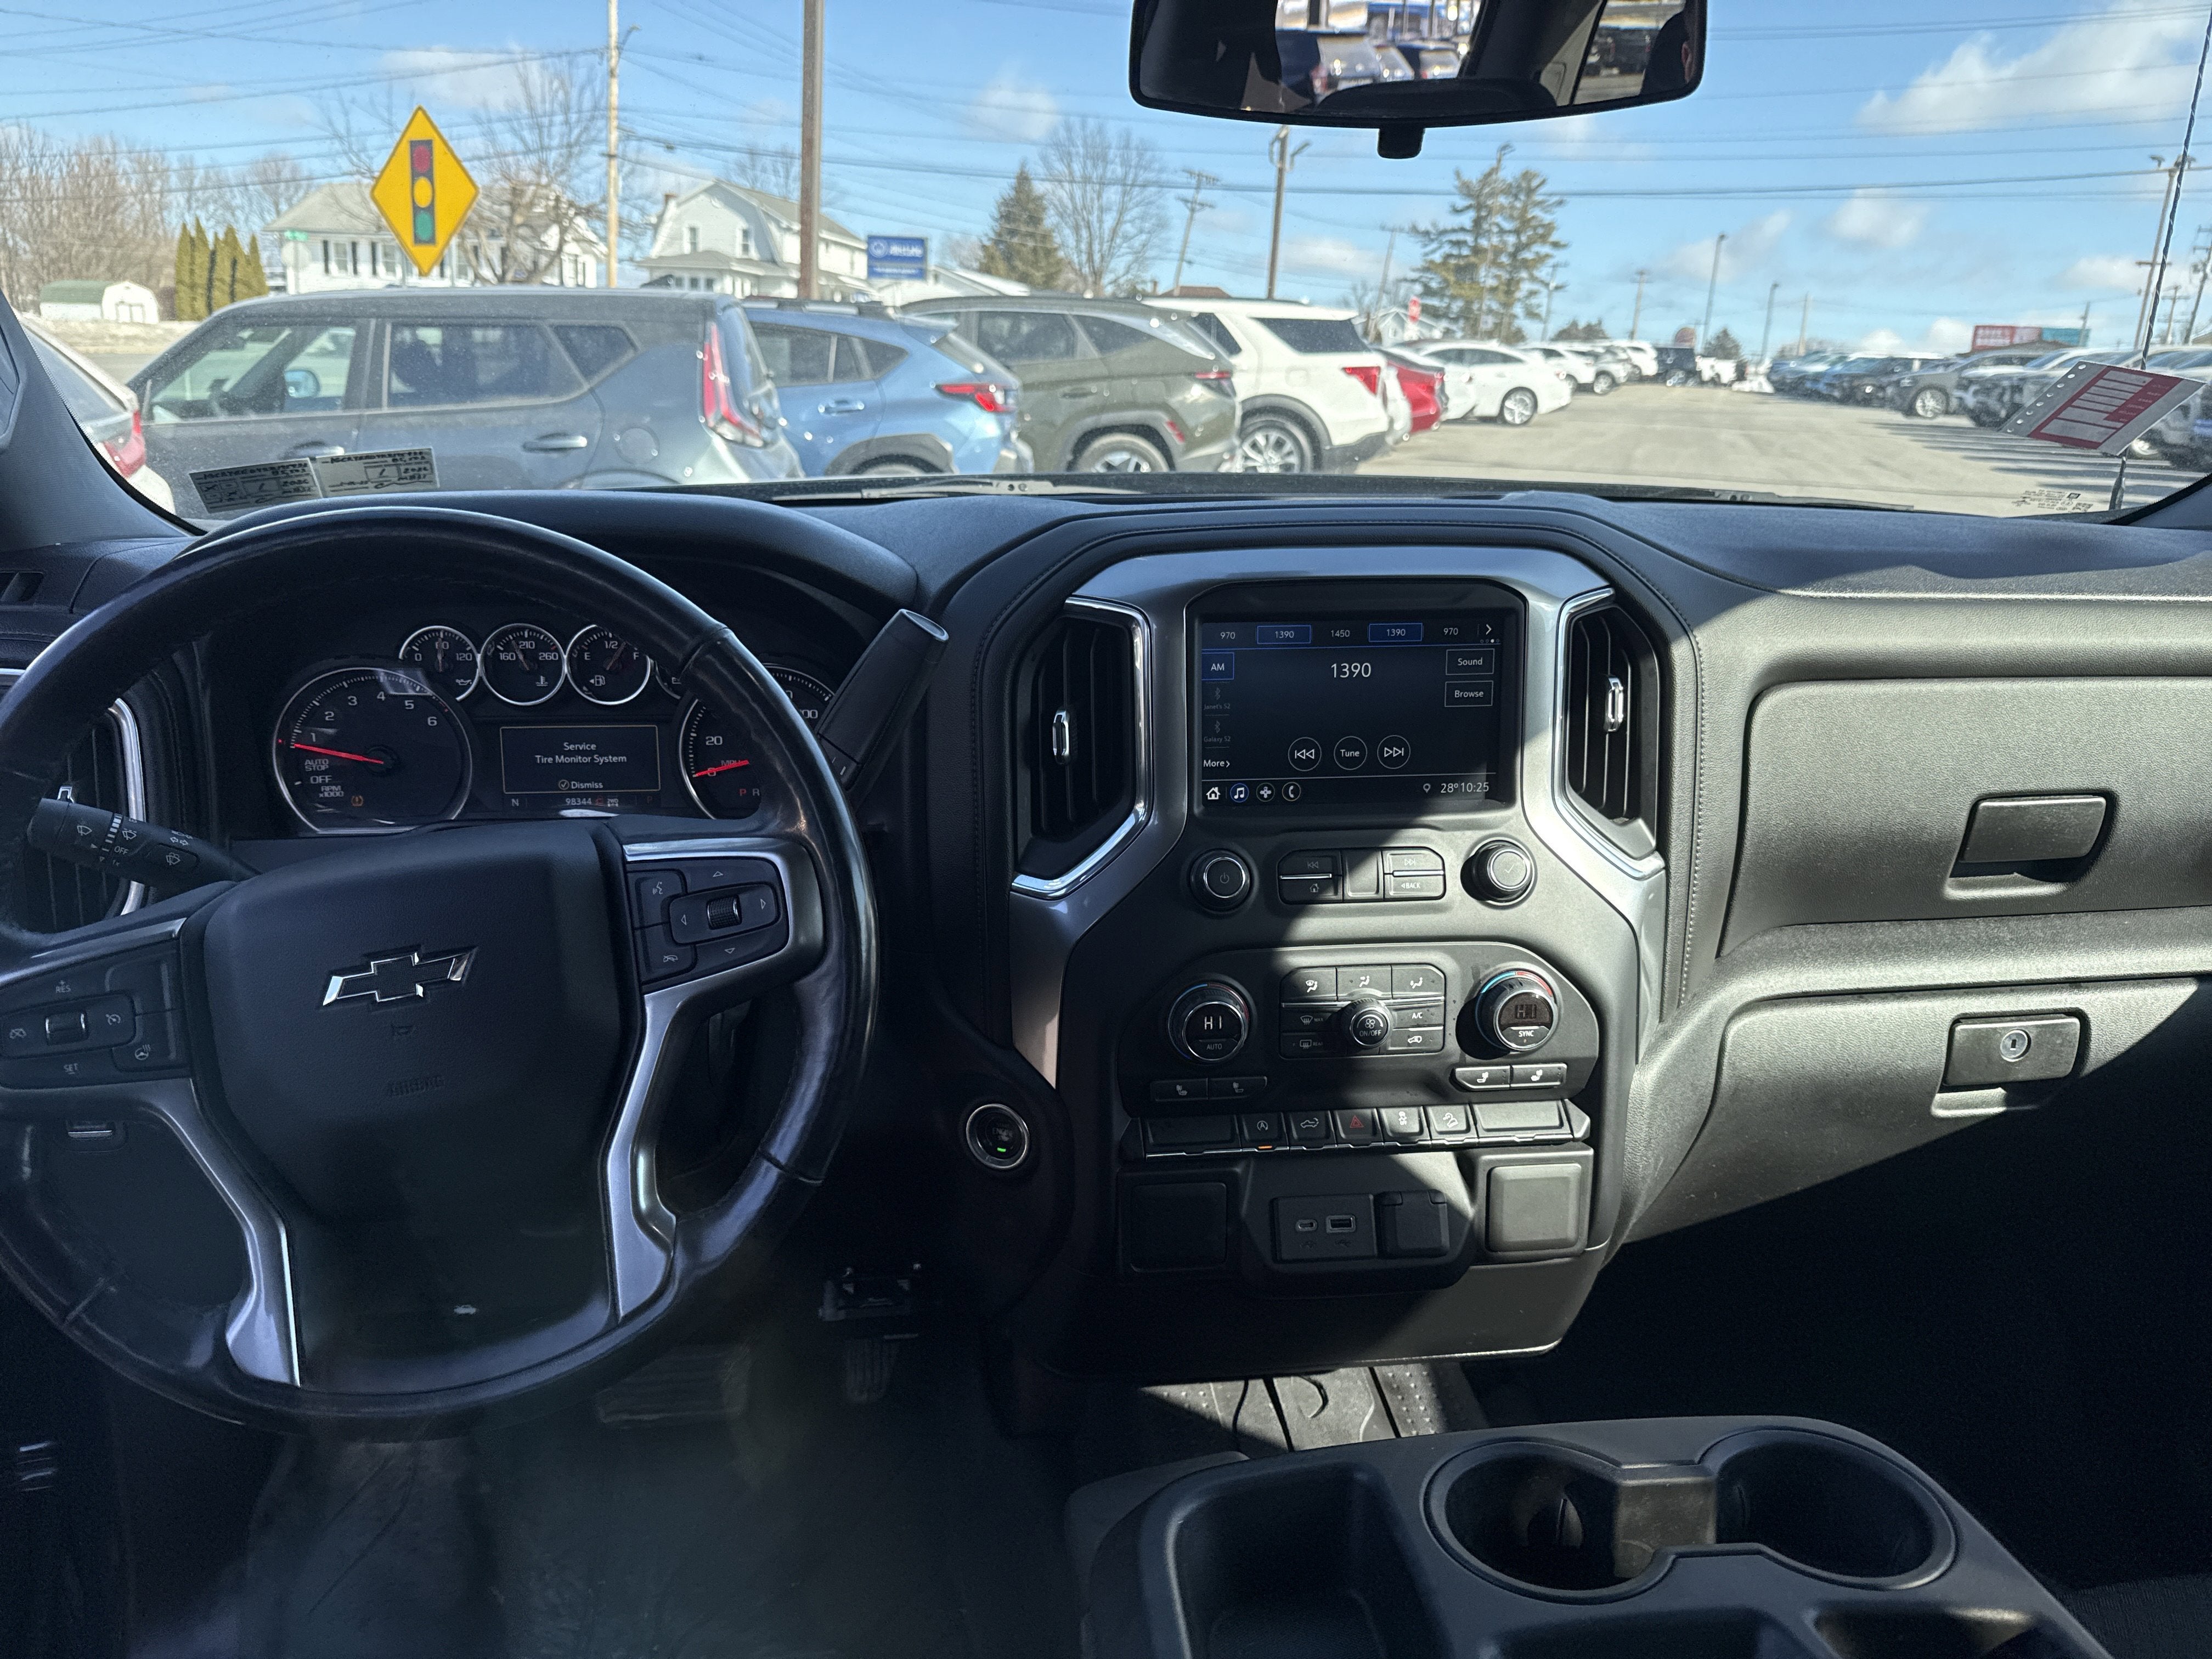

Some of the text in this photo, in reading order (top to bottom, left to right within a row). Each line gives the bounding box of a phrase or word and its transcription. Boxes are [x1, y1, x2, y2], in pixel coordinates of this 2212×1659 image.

[1220, 631, 1235, 640] 970
[1274, 630, 1294, 639] 1390
[1330, 629, 1350, 637] 1450
[1386, 628, 1406, 636] 1390
[1443, 627, 1458, 636] 970
[519, 640, 535, 650] 210
[605, 641, 618, 649] 1/2
[414, 653, 422, 662] 0
[456, 653, 472, 661] 120
[499, 652, 516, 661] 160
[539, 652, 558, 661] 260
[584, 652, 591, 661] E
[633, 652, 639, 660] F
[1458, 657, 1482, 666] Sound
[1210, 663, 1224, 672] AM
[1330, 662, 1372, 679] 1390
[376, 691, 386, 701] 4
[1454, 690, 1484, 698] Browse
[347, 696, 358, 706] 3
[404, 699, 414, 710] 5
[324, 710, 335, 721] 2
[801, 709, 818, 719] 00
[427, 716, 437, 726] 6
[311, 732, 316, 742] 1
[706, 736, 723, 746] 20
[563, 742, 596, 751] Service
[535, 754, 627, 765] Tire Monitor System
[1204, 759, 1224, 768] More
[310, 775, 332, 784] OFF
[1460, 782, 1489, 793] 10:25
[114, 845, 129, 855] OFF
[55, 985, 71, 993] RES
[1203, 1014, 1223, 1030] HI
[1359, 1029, 1381, 1037] ON/OFF
[64, 1063, 78, 1072] SET
